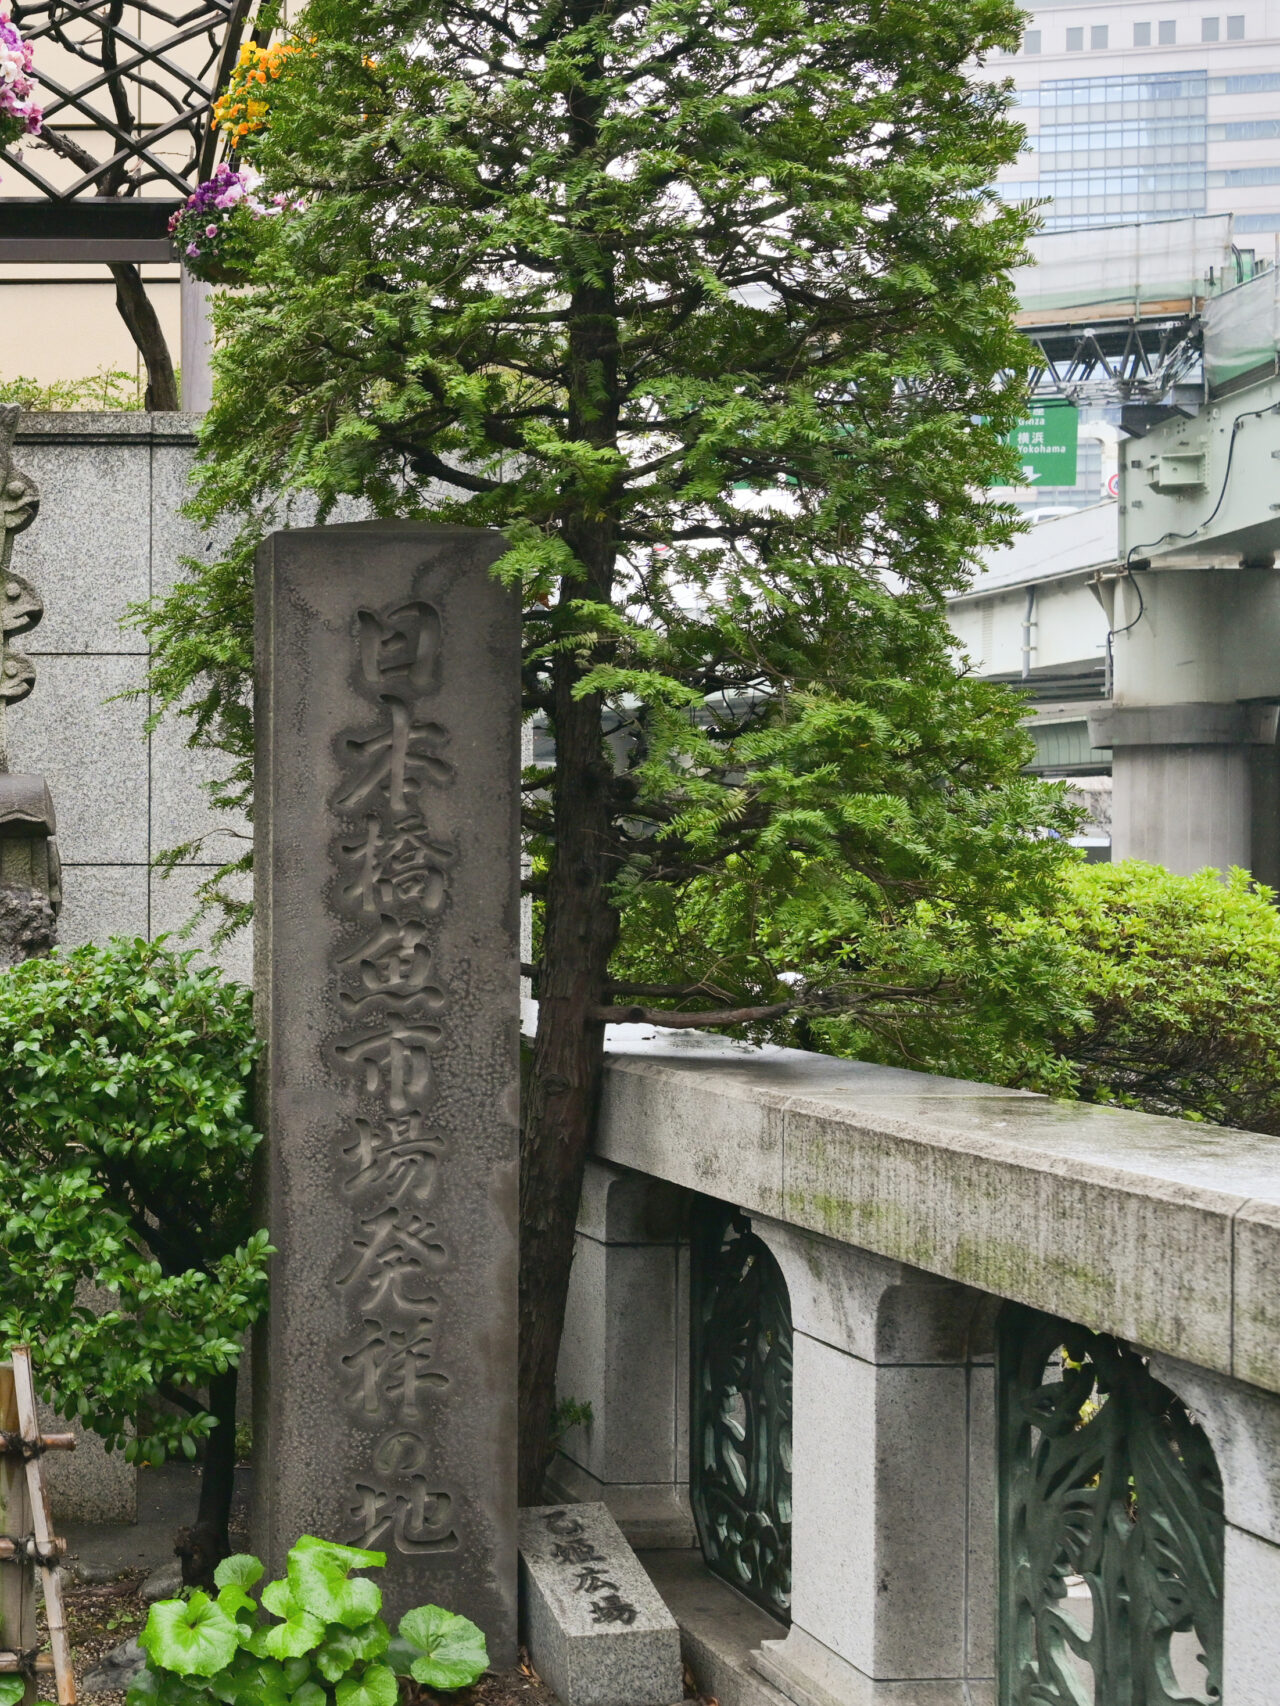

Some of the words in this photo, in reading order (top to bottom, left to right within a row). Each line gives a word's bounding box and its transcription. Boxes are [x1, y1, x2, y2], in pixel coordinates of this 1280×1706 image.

[1018, 432, 1045, 444] 横浜
[1017, 444, 1066, 454] Yokohama
[334, 599, 458, 1556] 日本橋魚市場発祥の地
